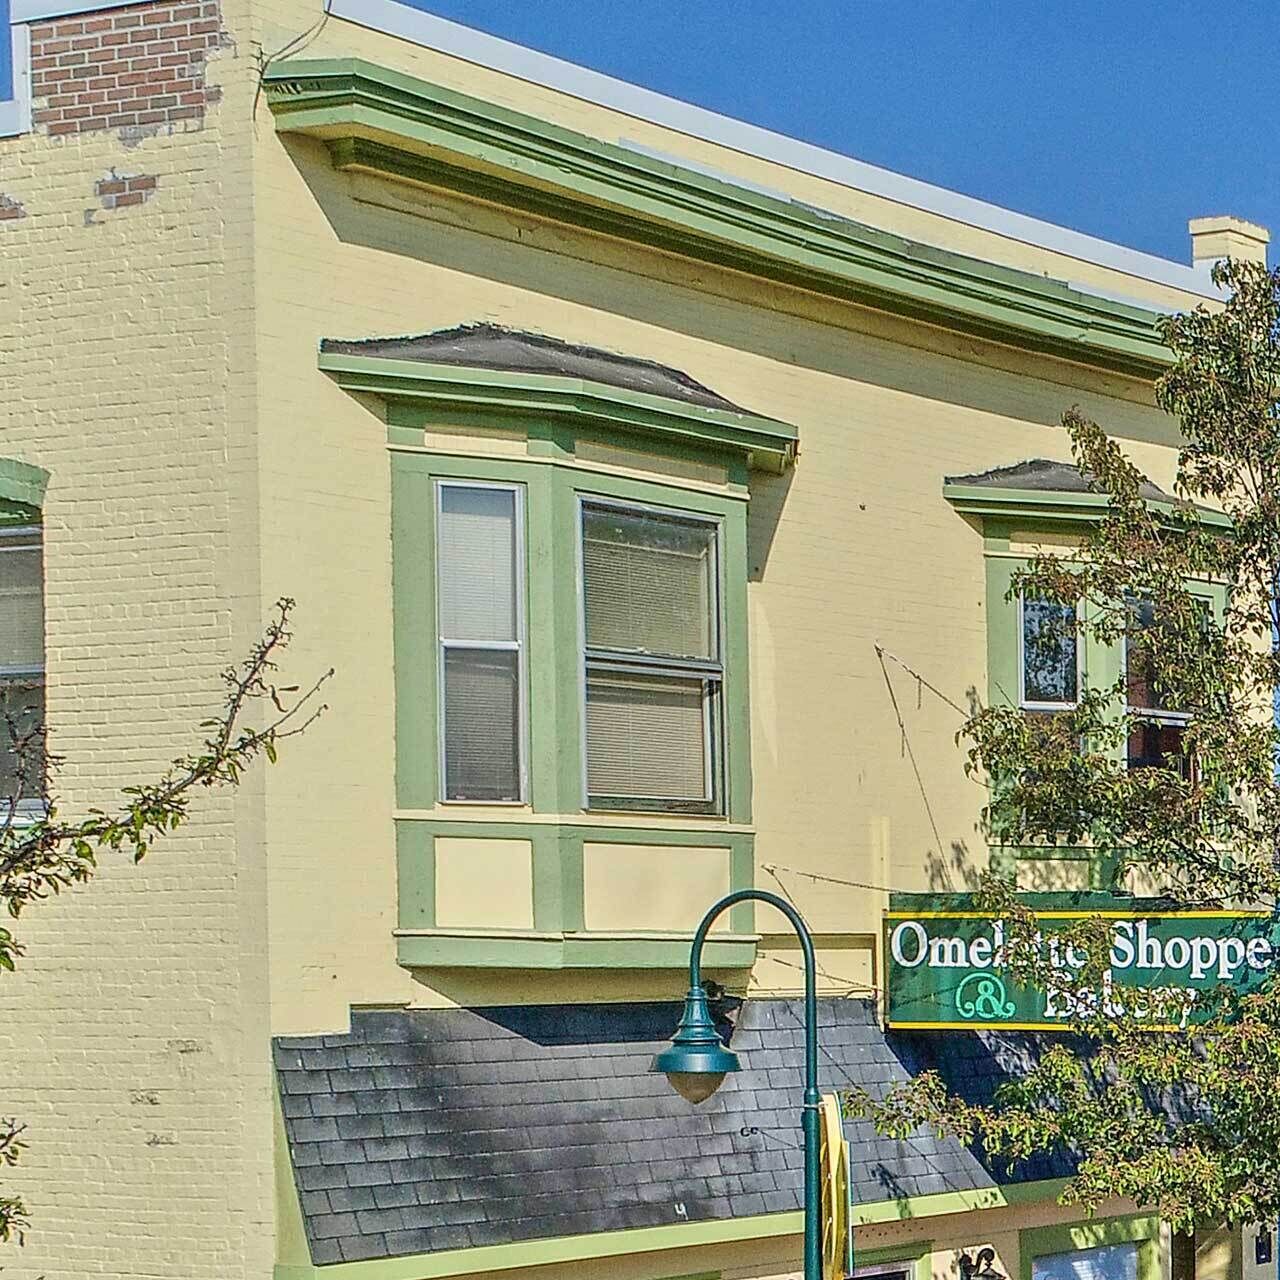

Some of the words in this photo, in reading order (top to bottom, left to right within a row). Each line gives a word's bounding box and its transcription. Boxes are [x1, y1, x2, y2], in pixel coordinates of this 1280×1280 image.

[891, 919, 1089, 969] Omeltte
[1109, 918, 1272, 979] Shoppe
[956, 972, 1016, 1019] &
